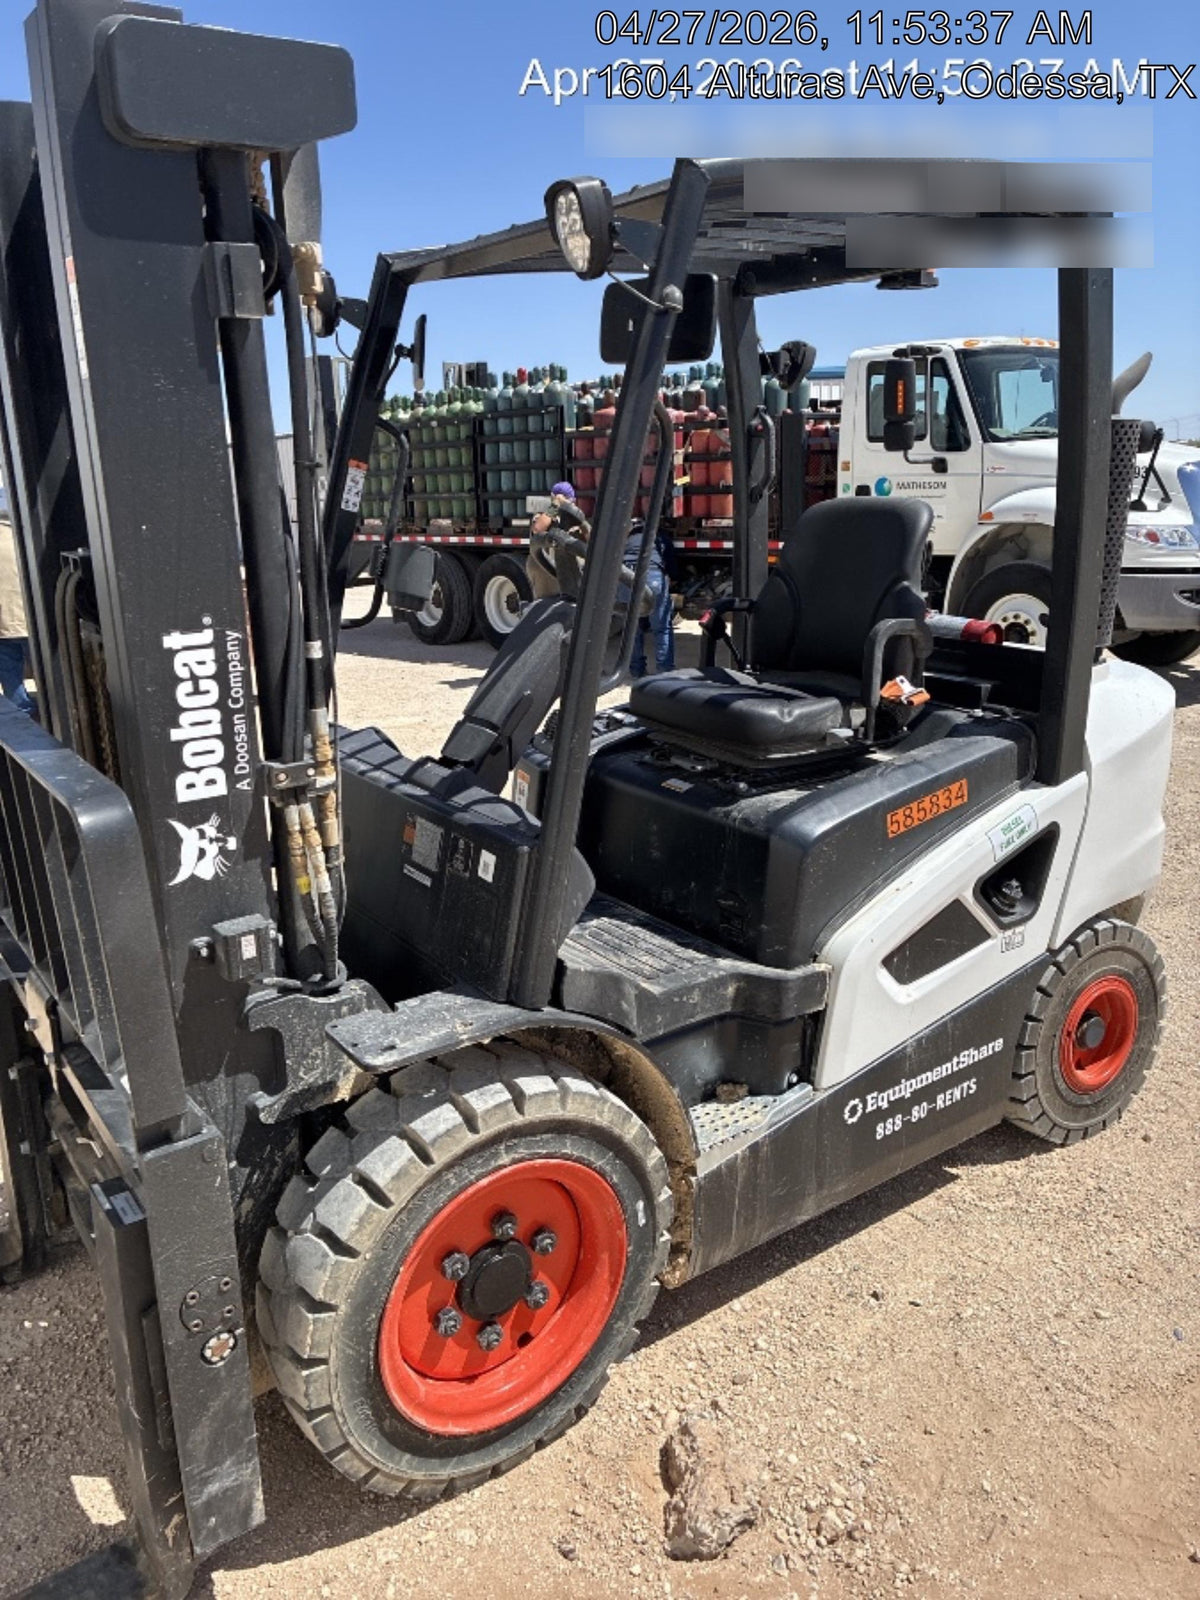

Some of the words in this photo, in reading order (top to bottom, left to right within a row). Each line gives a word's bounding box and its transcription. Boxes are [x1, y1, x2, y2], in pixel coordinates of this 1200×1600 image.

[896, 481, 947, 490] MATHESON
[225, 630, 245, 709] Company
[162, 628, 228, 803] Bobcat
[233, 713, 250, 775] Doosan
[235, 778, 251, 790] A
[889, 781, 966, 835] 585834
[865, 1038, 1004, 1113] EquipmentShare
[876, 1078, 977, 1140] 888-80-RENTS
